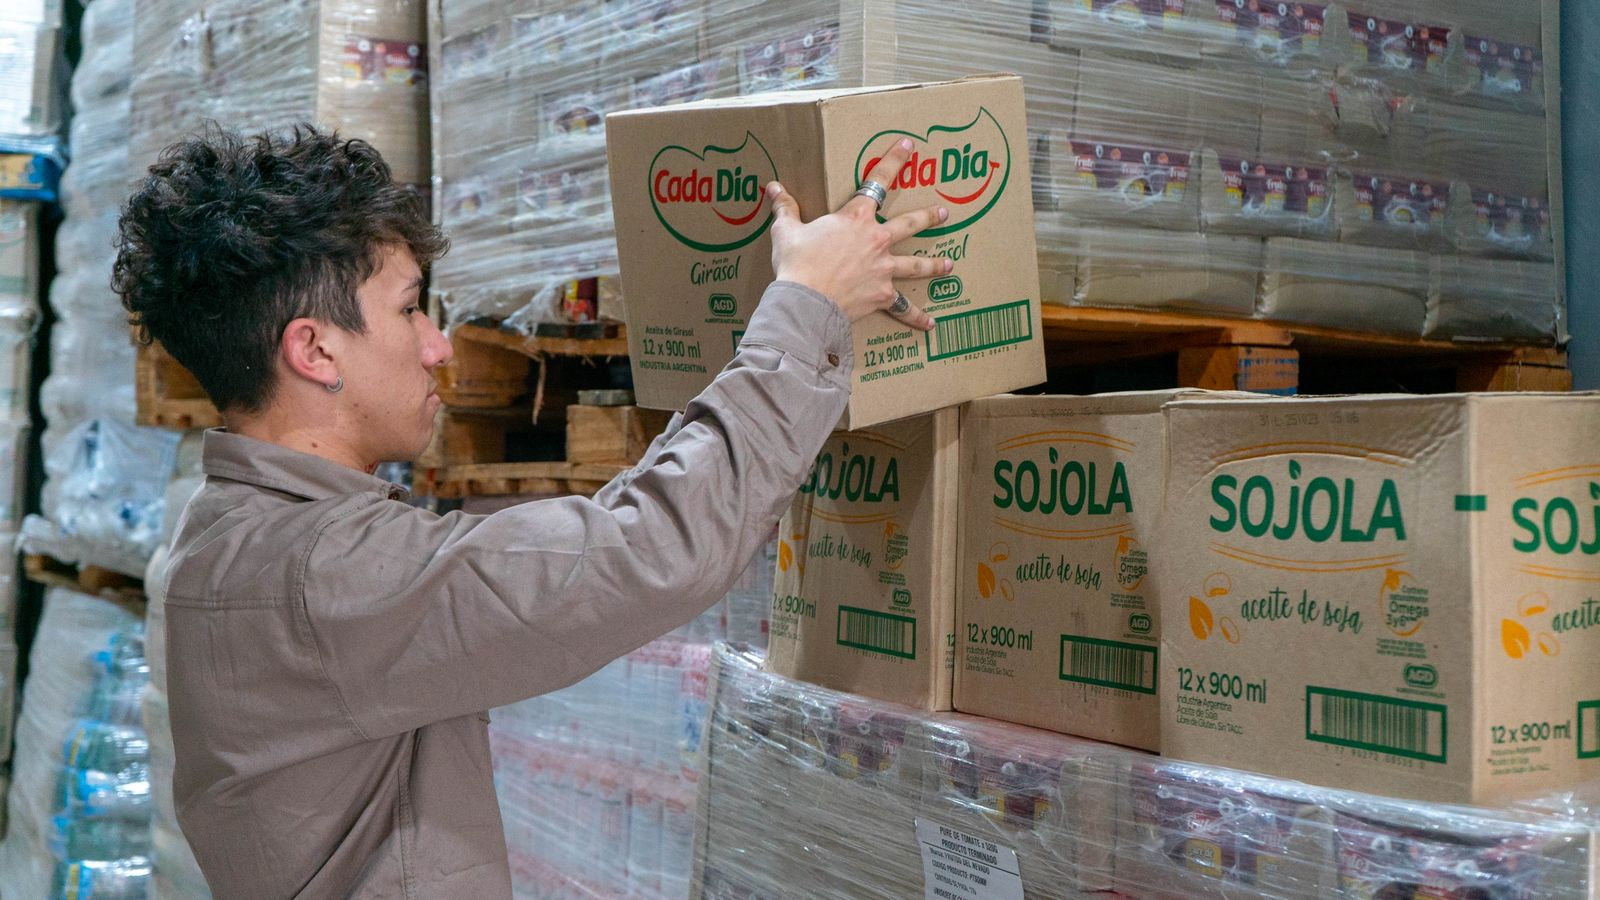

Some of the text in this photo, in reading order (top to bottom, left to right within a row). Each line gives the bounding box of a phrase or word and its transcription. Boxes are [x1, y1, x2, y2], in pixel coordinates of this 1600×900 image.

[690, 255, 741, 286] Girasol
[933, 282, 958, 298] AGD
[713, 299, 734, 311] AGD
[645, 326, 694, 337] Aceite de Girasol
[867, 329, 912, 346] Aceite de Girasol
[643, 339, 701, 358] 12 x 900 ml
[863, 340, 919, 368] 12 x 900 ml
[640, 360, 707, 374] INDUSTRIA ARGENTINA
[860, 361, 924, 383] INDUSTRIA ARGENTINA
[808, 534, 872, 568] aceite de soja
[1016, 553, 1103, 591] aceite de soja
[1120, 562, 1148, 575] Omega
[785, 595, 805, 615] 900
[805, 600, 817, 618] ml
[1241, 587, 1364, 634] aceite de soja
[1390, 601, 1429, 618] Omega
[967, 623, 1033, 651] 12 x 900 ml
[1178, 667, 1267, 704] 12 x 900 ml
[1176, 694, 1232, 712] Industria Argentina
[1176, 704, 1218, 720] Aceite de Soja
[1492, 720, 1571, 744] 12 x 900 ml
[953, 831, 960, 841] DE
[961, 833, 981, 848] TOMATE
[941, 838, 998, 865] PRODUCTO TERMINADO
